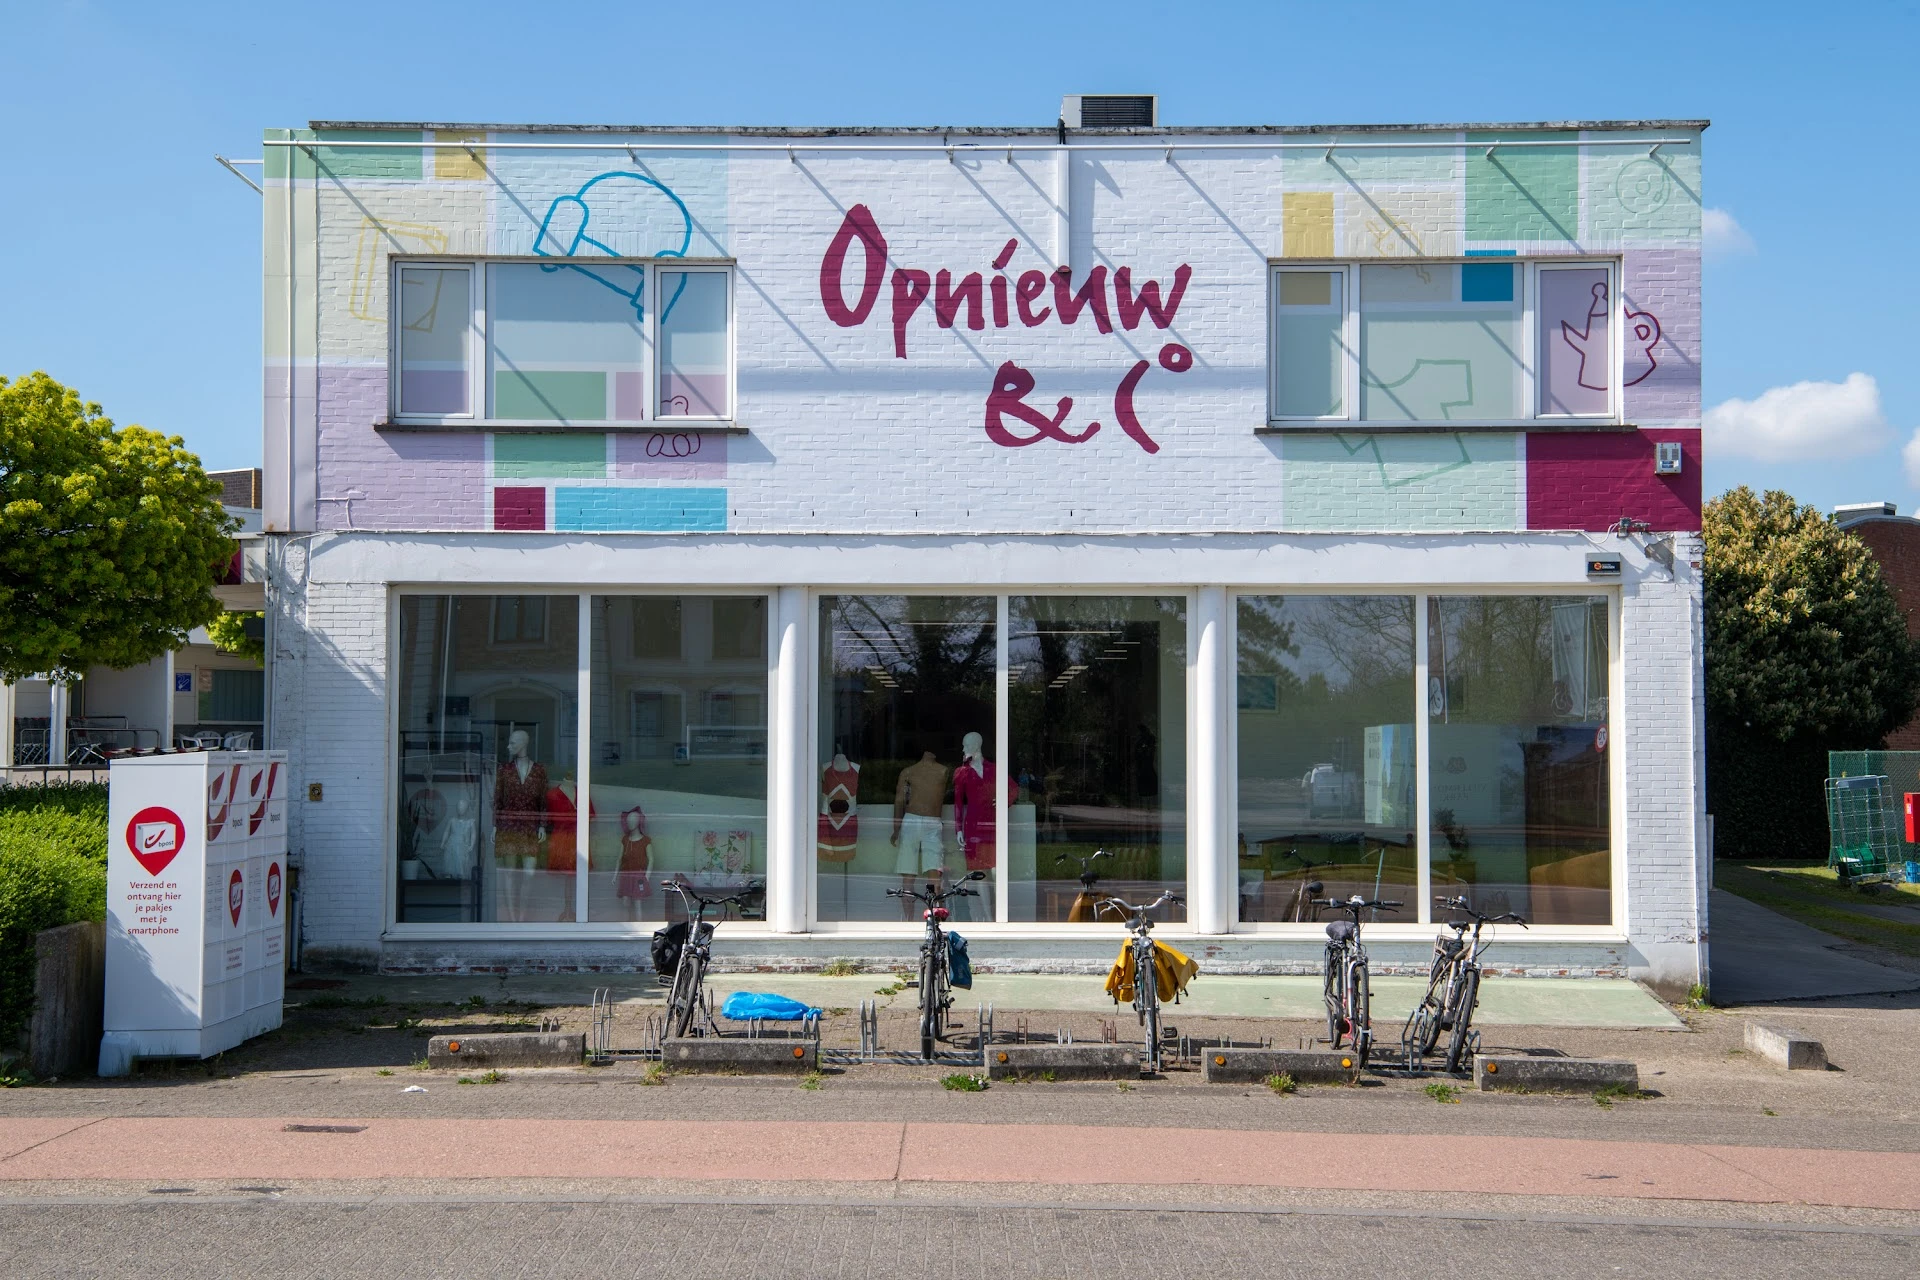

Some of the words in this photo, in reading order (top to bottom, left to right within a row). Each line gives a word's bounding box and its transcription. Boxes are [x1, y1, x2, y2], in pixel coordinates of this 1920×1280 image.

[984, 360, 1101, 448] &
[158, 840, 174, 848] bpost
[130, 880, 164, 889] Verzend
[127, 894, 163, 902] ontvang
[165, 892, 181, 900] hier
[135, 903, 143, 914] je
[145, 903, 172, 914] pakjes
[159, 915, 167, 925] je
[127, 926, 179, 936] smartphone
